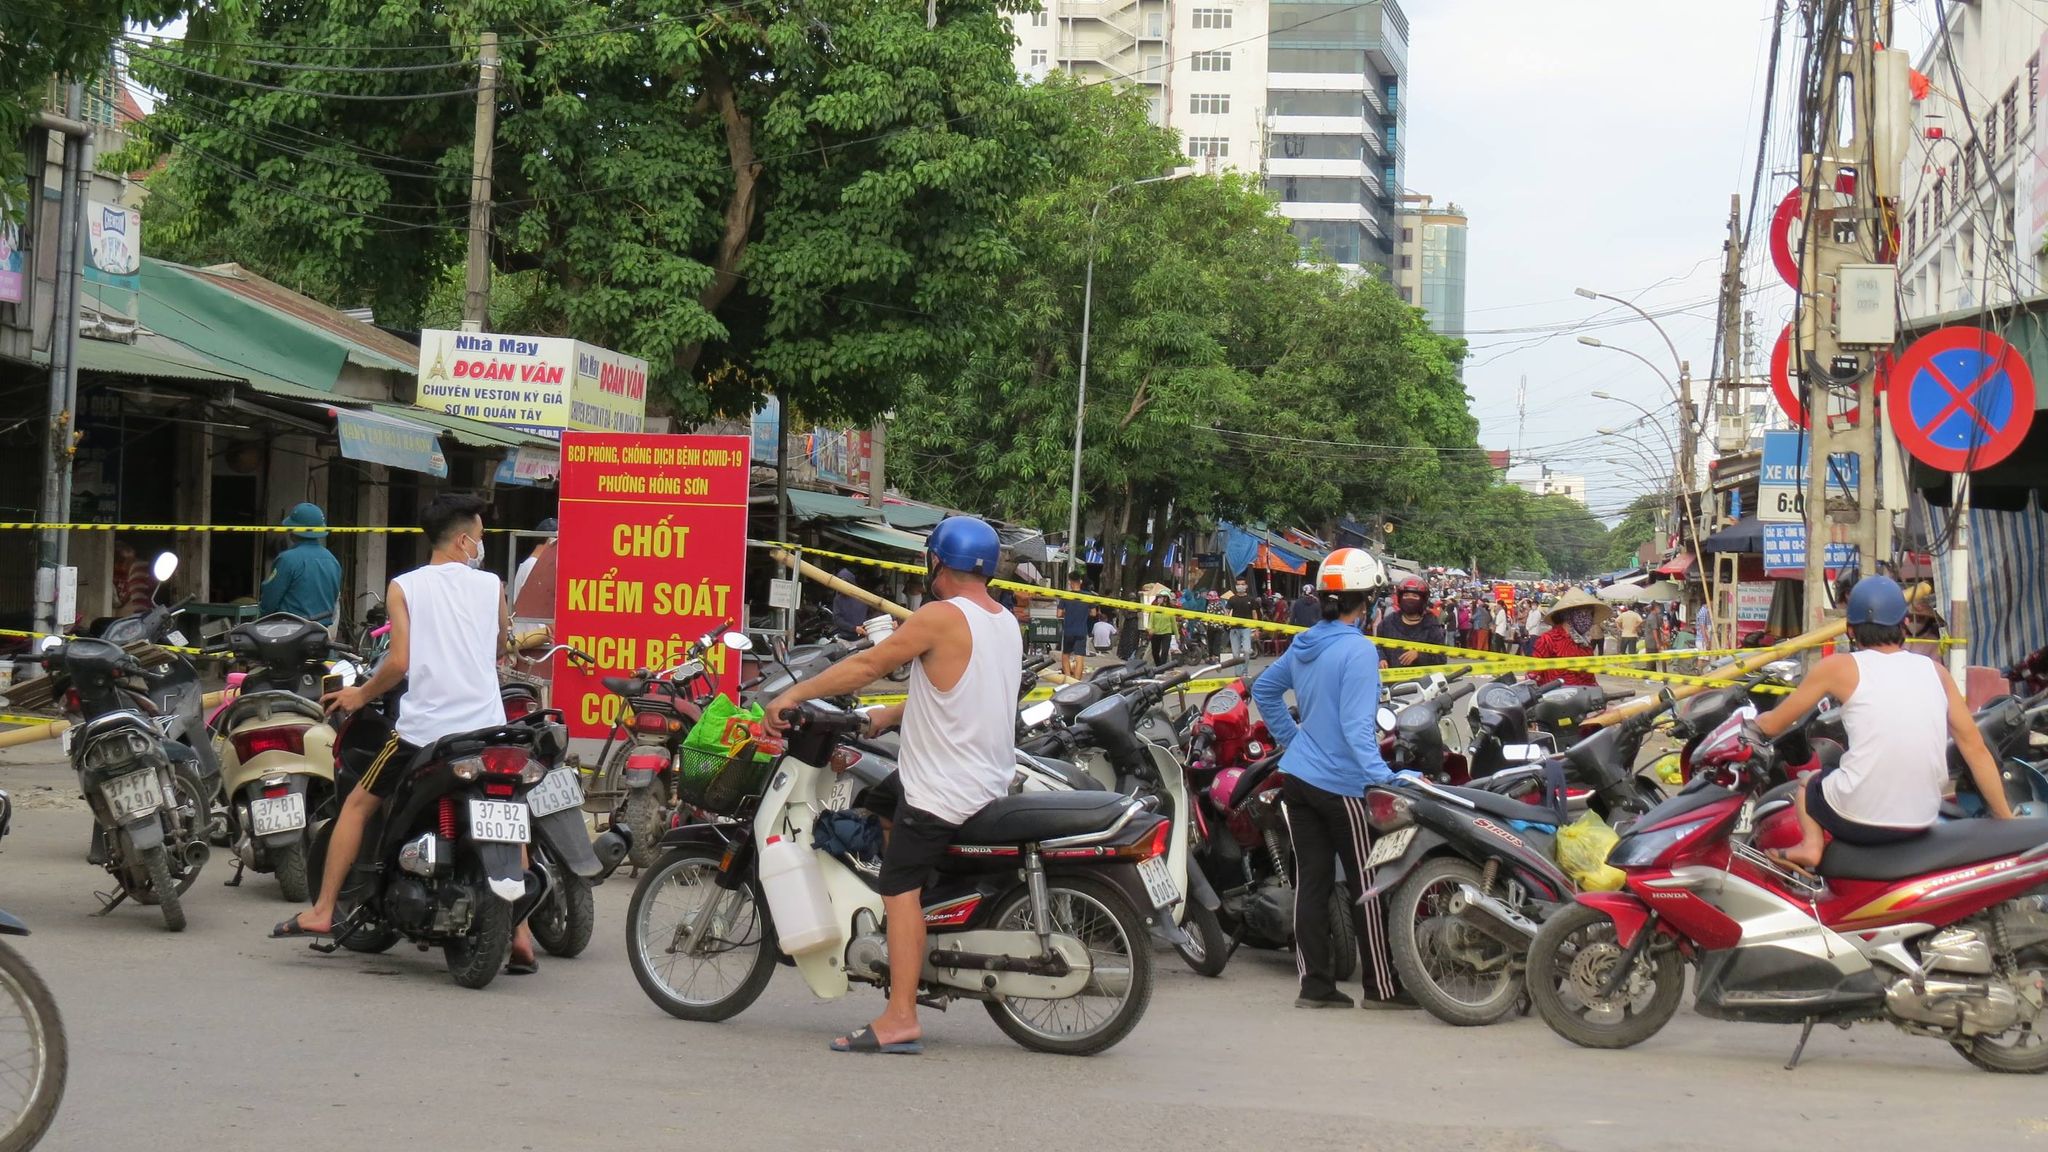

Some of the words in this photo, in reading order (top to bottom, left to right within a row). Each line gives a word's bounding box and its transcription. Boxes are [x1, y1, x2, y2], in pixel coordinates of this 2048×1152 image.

[456, 335, 492, 351] Nhà
[500, 338, 539, 356] May
[522, 362, 564, 385] VÂN
[423, 384, 470, 398] CHUYÊN
[474, 388, 520, 402] VESTON
[465, 405, 479, 416] MI
[520, 408, 542, 421] TÂY
[622, 441, 651, 465] CHỐNG
[654, 449, 675, 468] DỊCH
[677, 445, 700, 469] BỆNH
[702, 450, 742, 467] COVID-19
[1765, 464, 1782, 479] XE
[598, 472, 646, 494] PHƯỜNG
[650, 471, 681, 495] HỒNG
[684, 477, 709, 496] SƠN
[613, 514, 689, 558] CHỐT
[568, 567, 643, 614] KIỂM
[653, 577, 730, 617] SOÁT
[567, 635, 636, 676] DỊCH
[479, 803, 520, 821] 37-B2
[475, 821, 527, 840] 960.78
